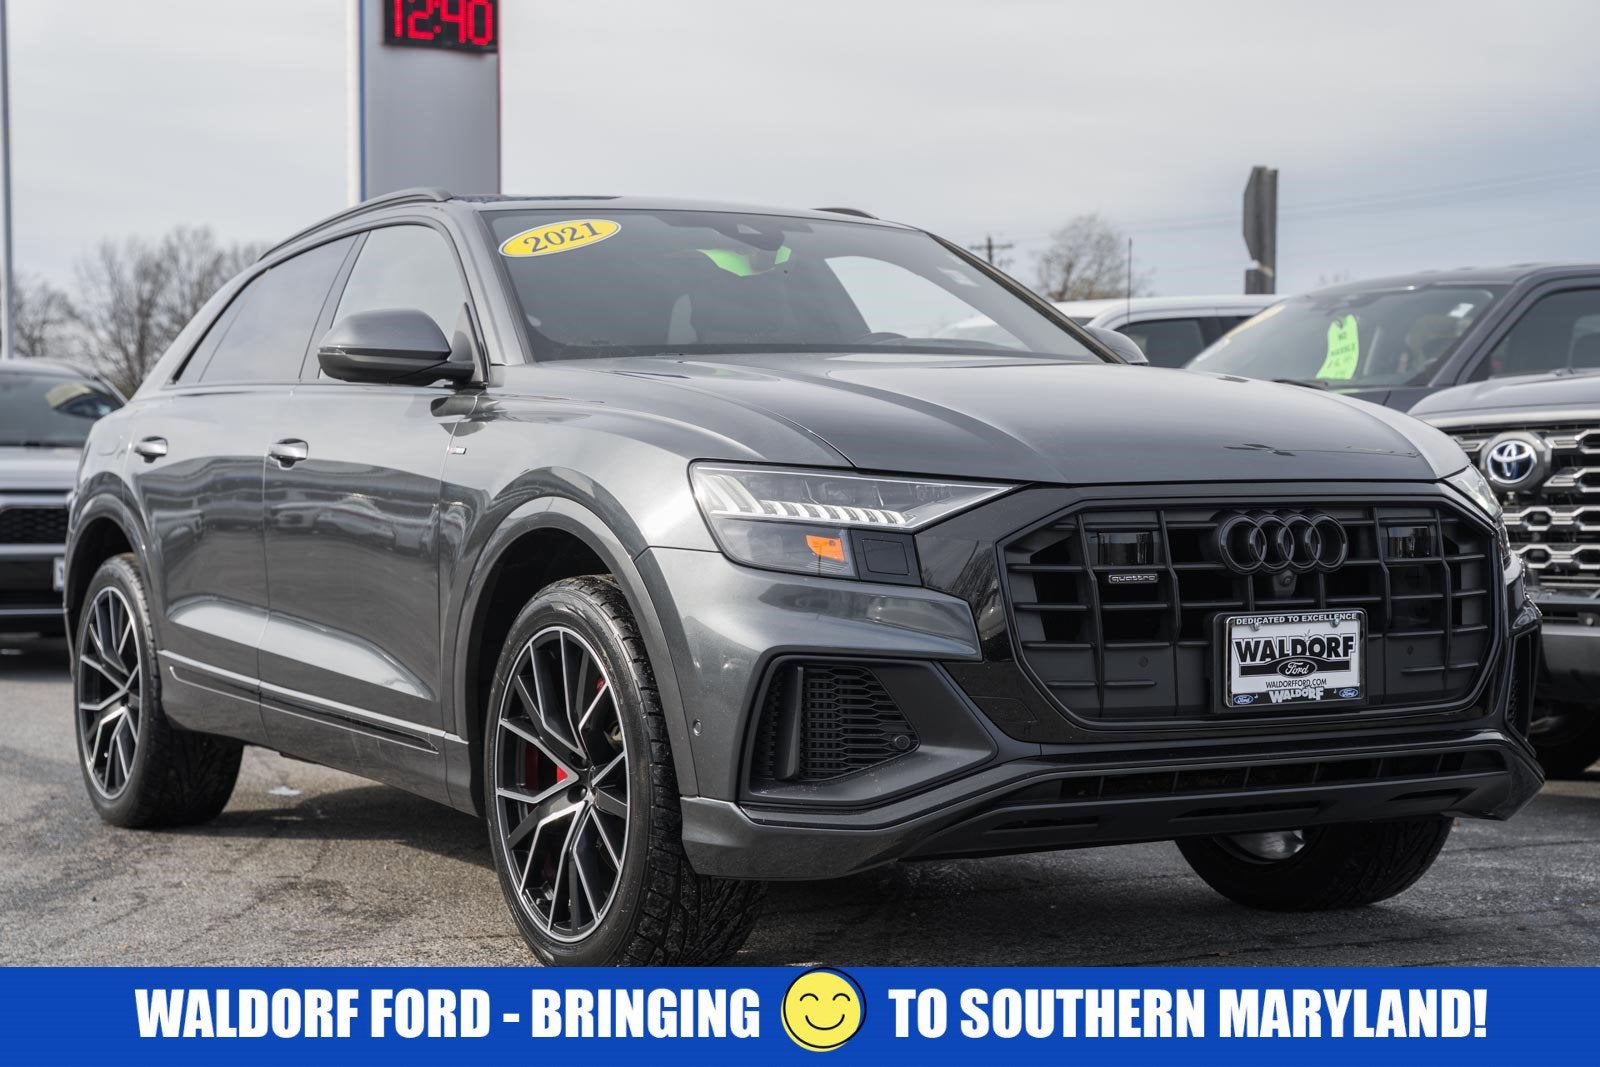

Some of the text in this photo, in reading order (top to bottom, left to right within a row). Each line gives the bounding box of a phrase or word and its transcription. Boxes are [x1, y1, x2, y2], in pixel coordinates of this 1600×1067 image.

[394, 0, 493, 45] 12:40
[523, 222, 602, 253] 2021
[1111, 575, 1155, 583] quattro
[1236, 616, 1284, 625] DEDICATED
[1301, 612, 1357, 622] EXCELLENCE
[1235, 635, 1355, 662] WALDORF
[1285, 662, 1309, 675] Ford
[1265, 678, 1327, 688] WALDORFFORD.COM
[1268, 686, 1324, 703] WALDORF
